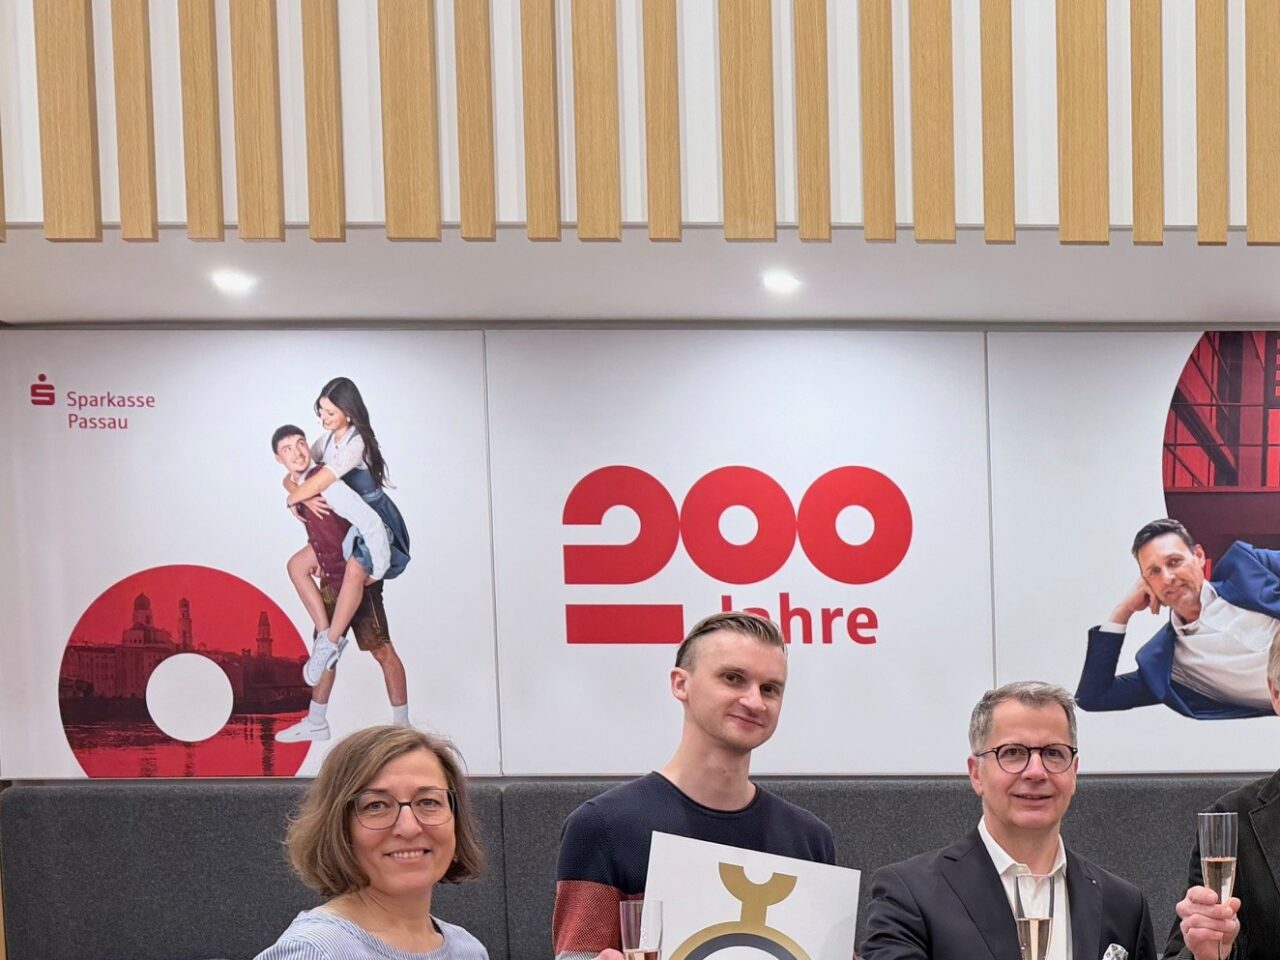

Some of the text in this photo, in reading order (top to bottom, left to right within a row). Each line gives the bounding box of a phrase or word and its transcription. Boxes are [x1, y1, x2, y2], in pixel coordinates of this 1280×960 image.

[66, 391, 156, 410] Sparkasse
[67, 413, 128, 430] Passau
[562, 465, 913, 586] 200
[721, 592, 879, 645] hre
